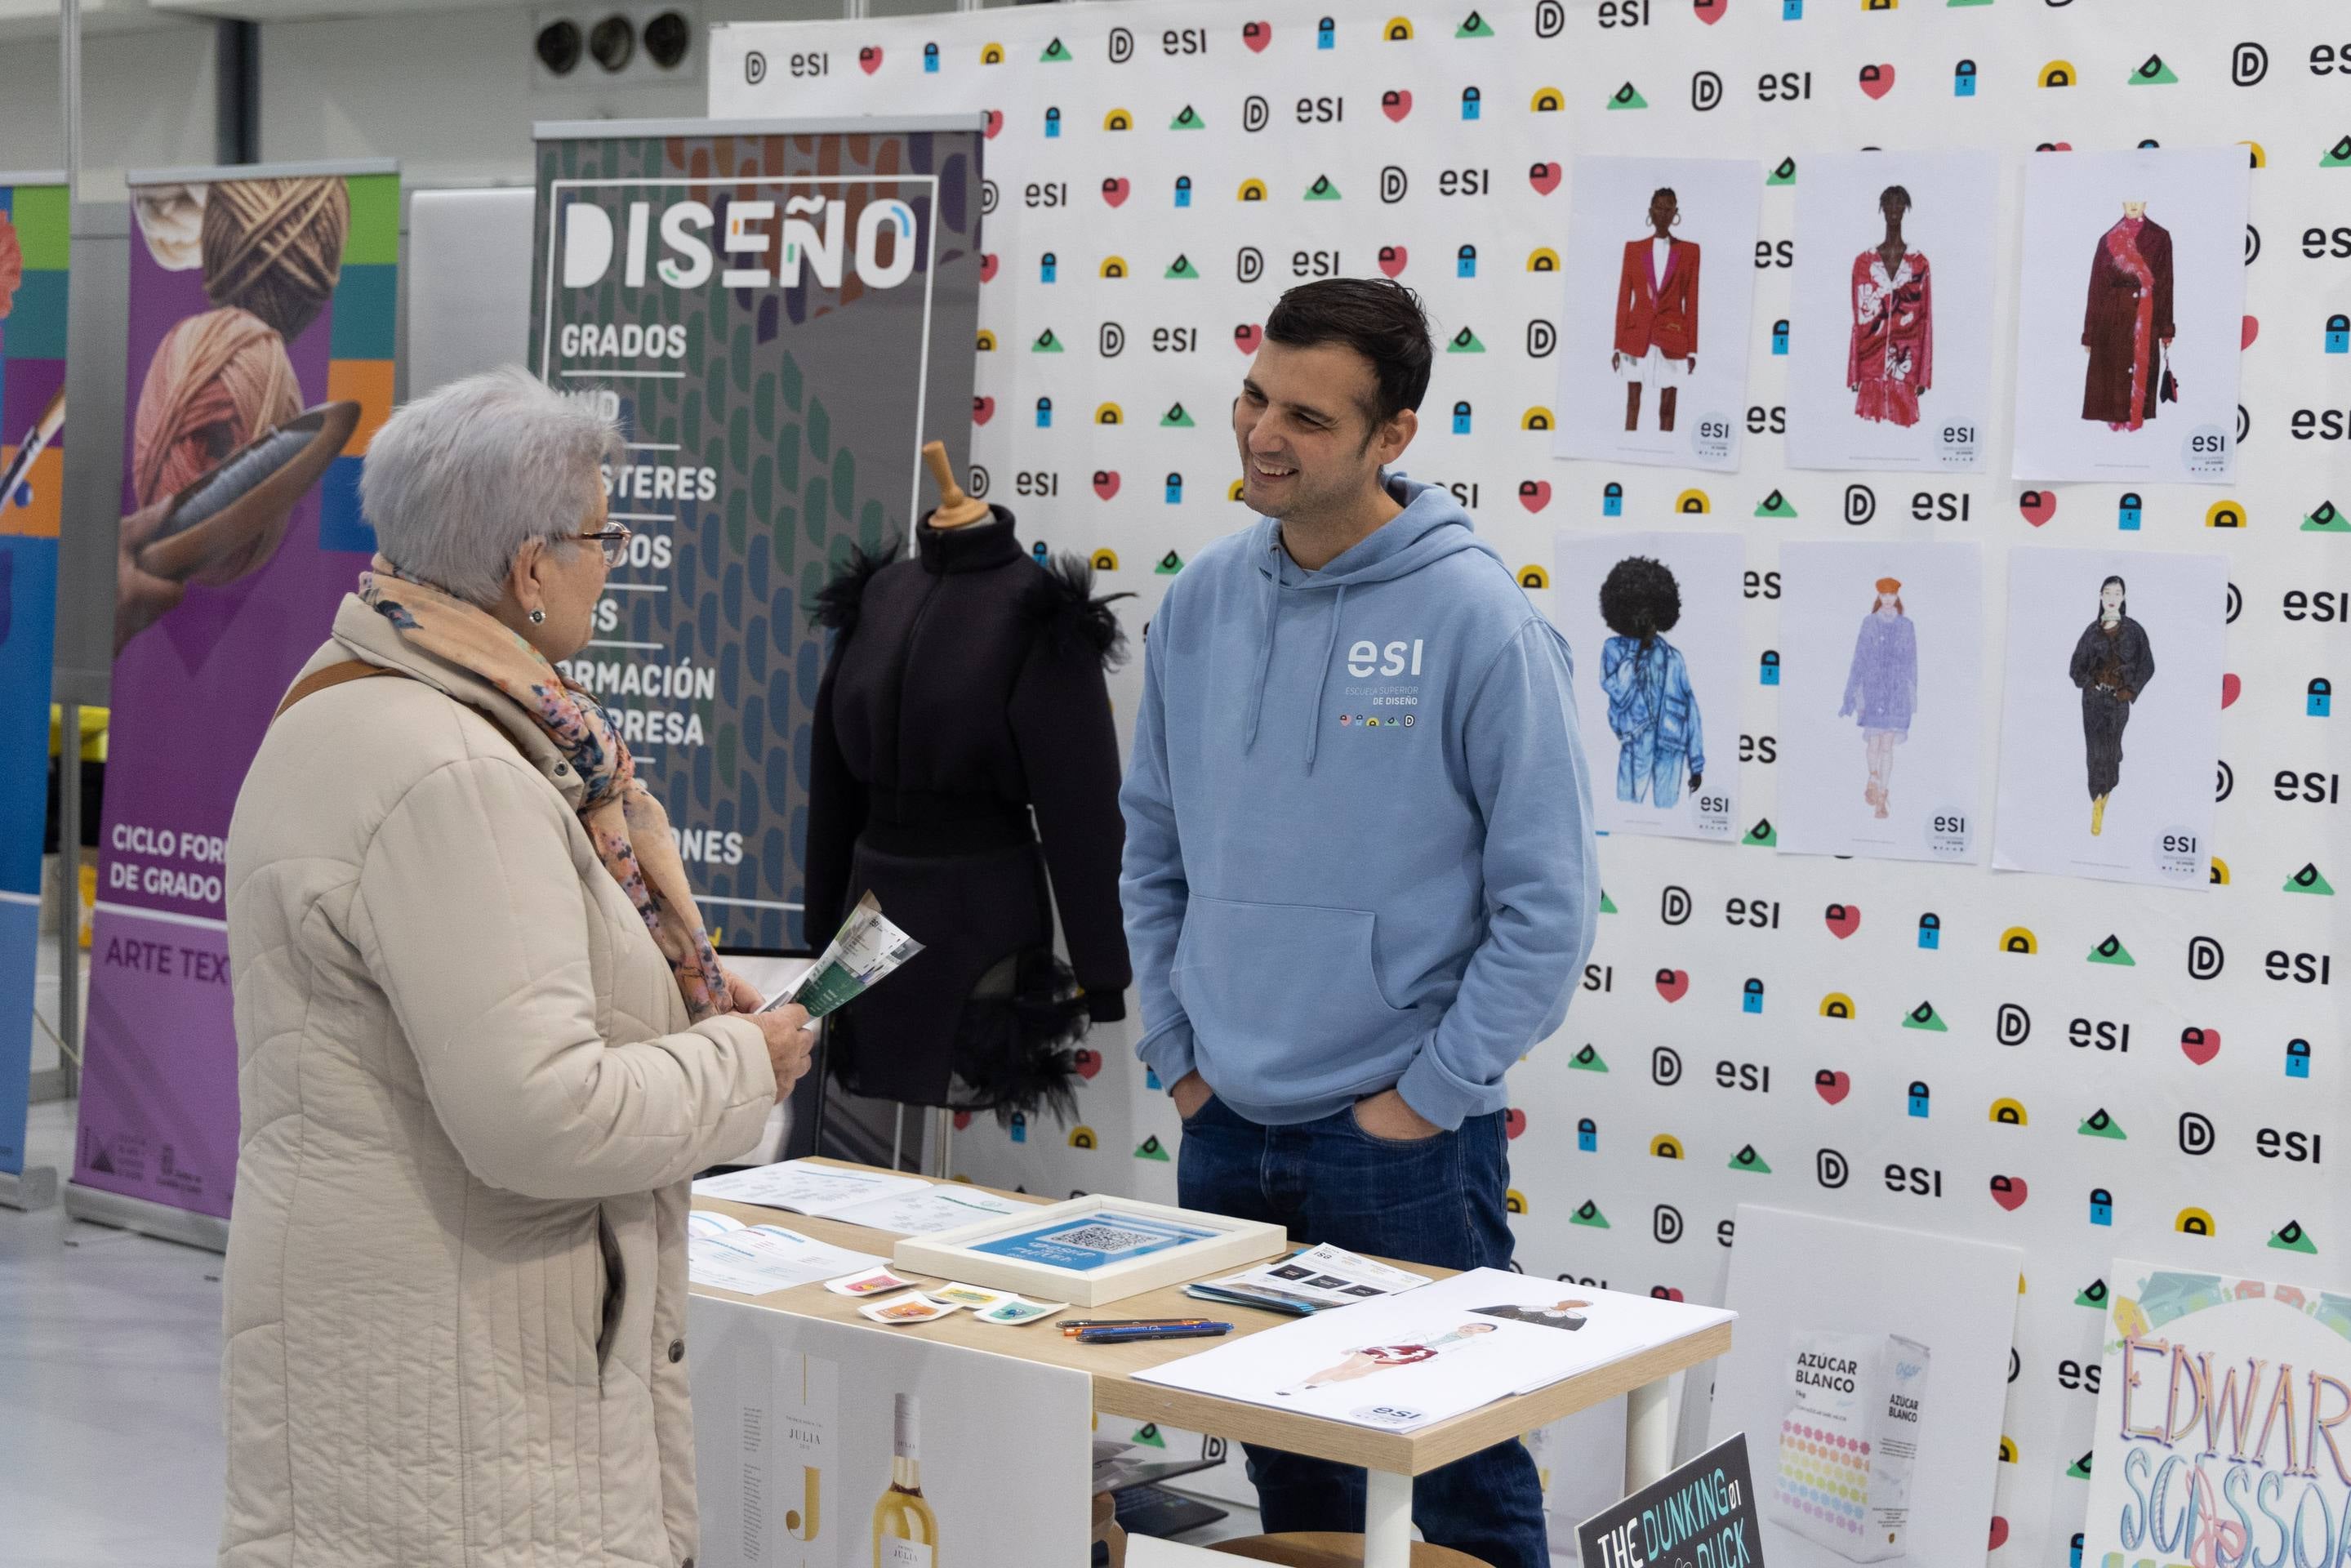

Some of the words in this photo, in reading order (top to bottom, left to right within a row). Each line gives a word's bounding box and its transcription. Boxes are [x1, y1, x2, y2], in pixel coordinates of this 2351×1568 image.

[563, 195, 917, 289] DISEÑO
[560, 323, 687, 359] GRADOS
[600, 463, 717, 501] STERES
[1345, 686, 1378, 696] ESCUELA
[1379, 686, 1418, 696] SUPERIOR
[1373, 697, 1383, 706] DE
[1386, 695, 1418, 706] DISEÑO
[112, 823, 176, 858] CICLO
[179, 831, 229, 866] FOR
[109, 862, 140, 891] DE
[143, 866, 222, 903] GRADO
[105, 938, 172, 974] ARTE
[1797, 1352, 1858, 1375] AZÚCAR
[1796, 1370, 1855, 1393] BLANCO
[1888, 1406, 1917, 1423] BLANCO
[789, 1428, 821, 1445] JULIA
[1597, 1517, 1644, 1568] THE
[1642, 1468, 1730, 1562] DUNKING
[893, 1549, 919, 1562] JULIA
